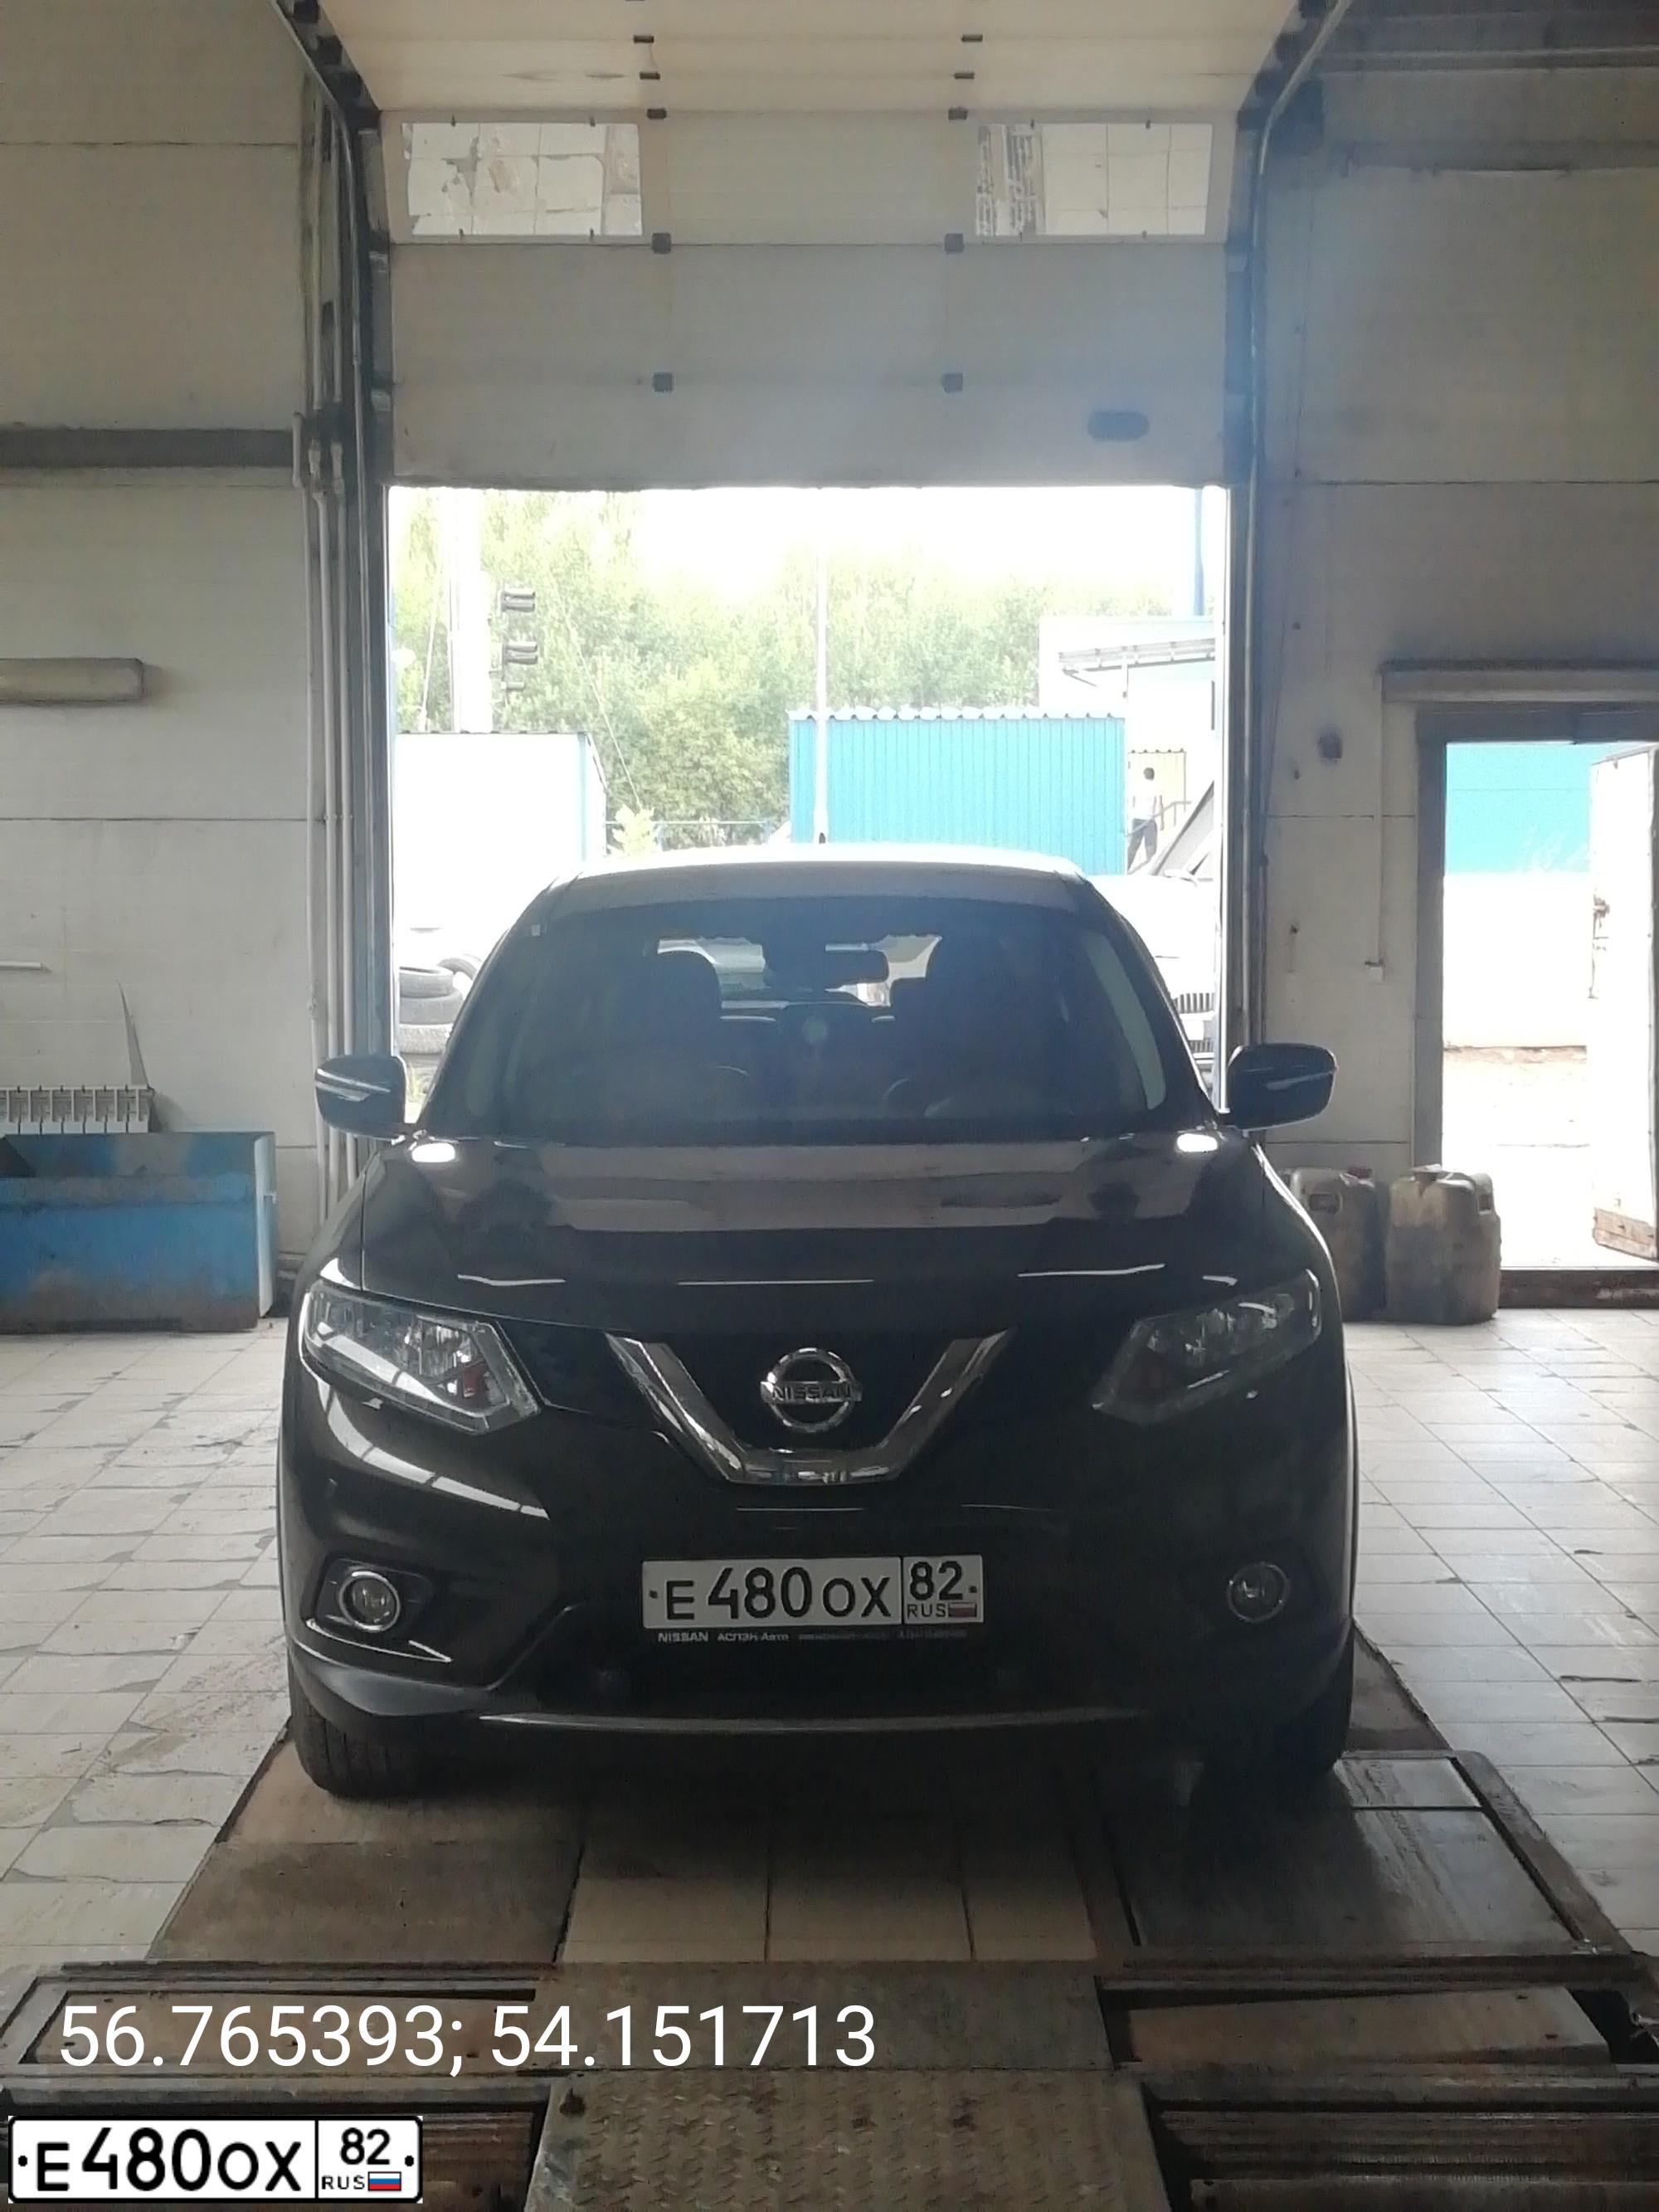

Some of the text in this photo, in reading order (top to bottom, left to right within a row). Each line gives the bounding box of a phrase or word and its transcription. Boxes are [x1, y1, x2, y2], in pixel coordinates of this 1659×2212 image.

[772, 1384, 851, 1401] NISSAN
[909, 1561, 963, 1601] 82
[907, 1603, 946, 1620] RUS
[658, 1632, 708, 1642] NISSAN
